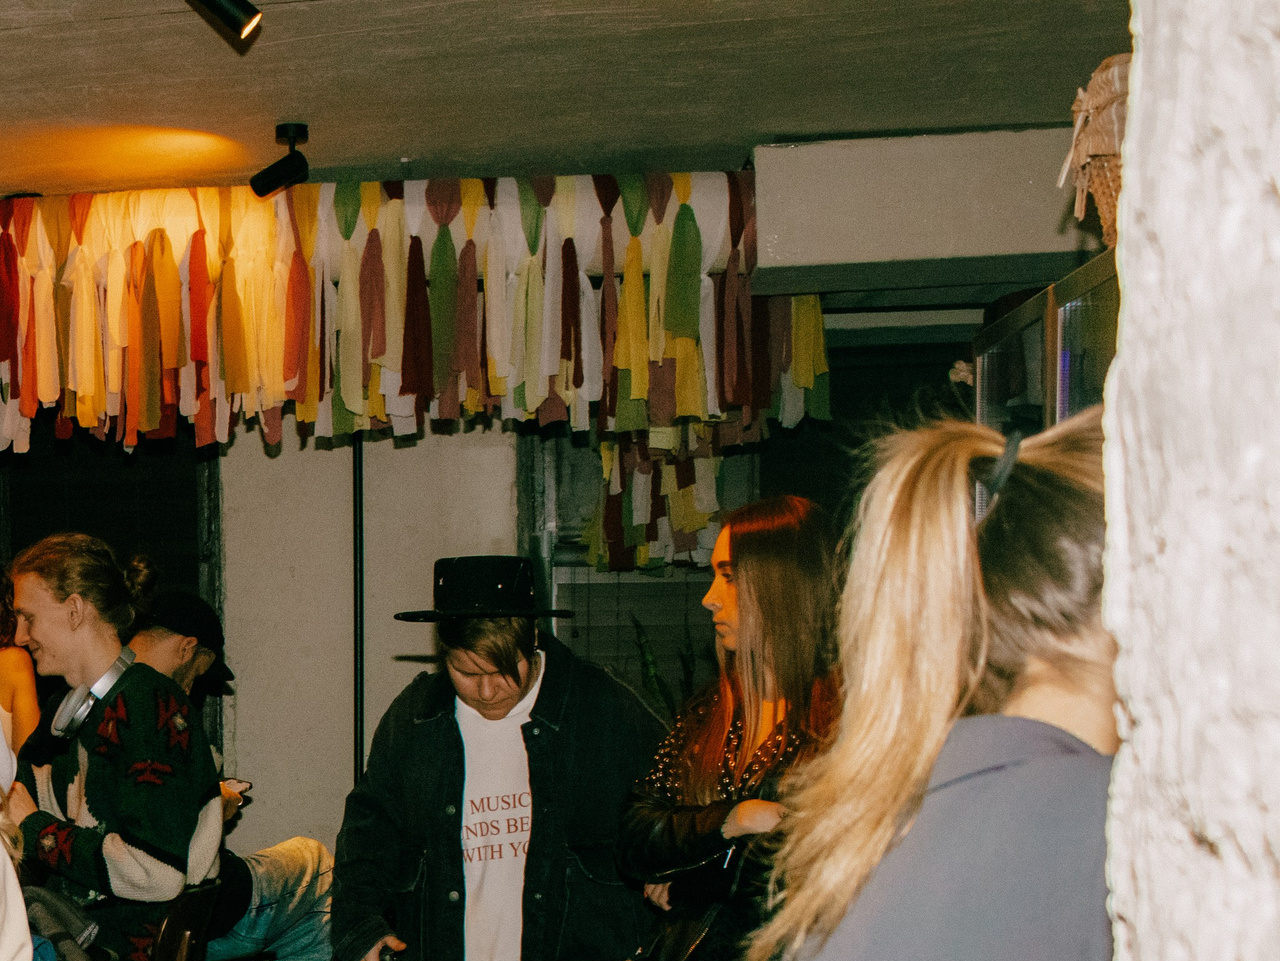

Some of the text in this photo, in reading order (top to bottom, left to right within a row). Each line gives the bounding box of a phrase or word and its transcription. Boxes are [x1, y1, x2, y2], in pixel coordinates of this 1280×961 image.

[469, 792, 531, 815] MUSIC
[462, 820, 500, 840] NDS
[463, 843, 503, 863] WITH
